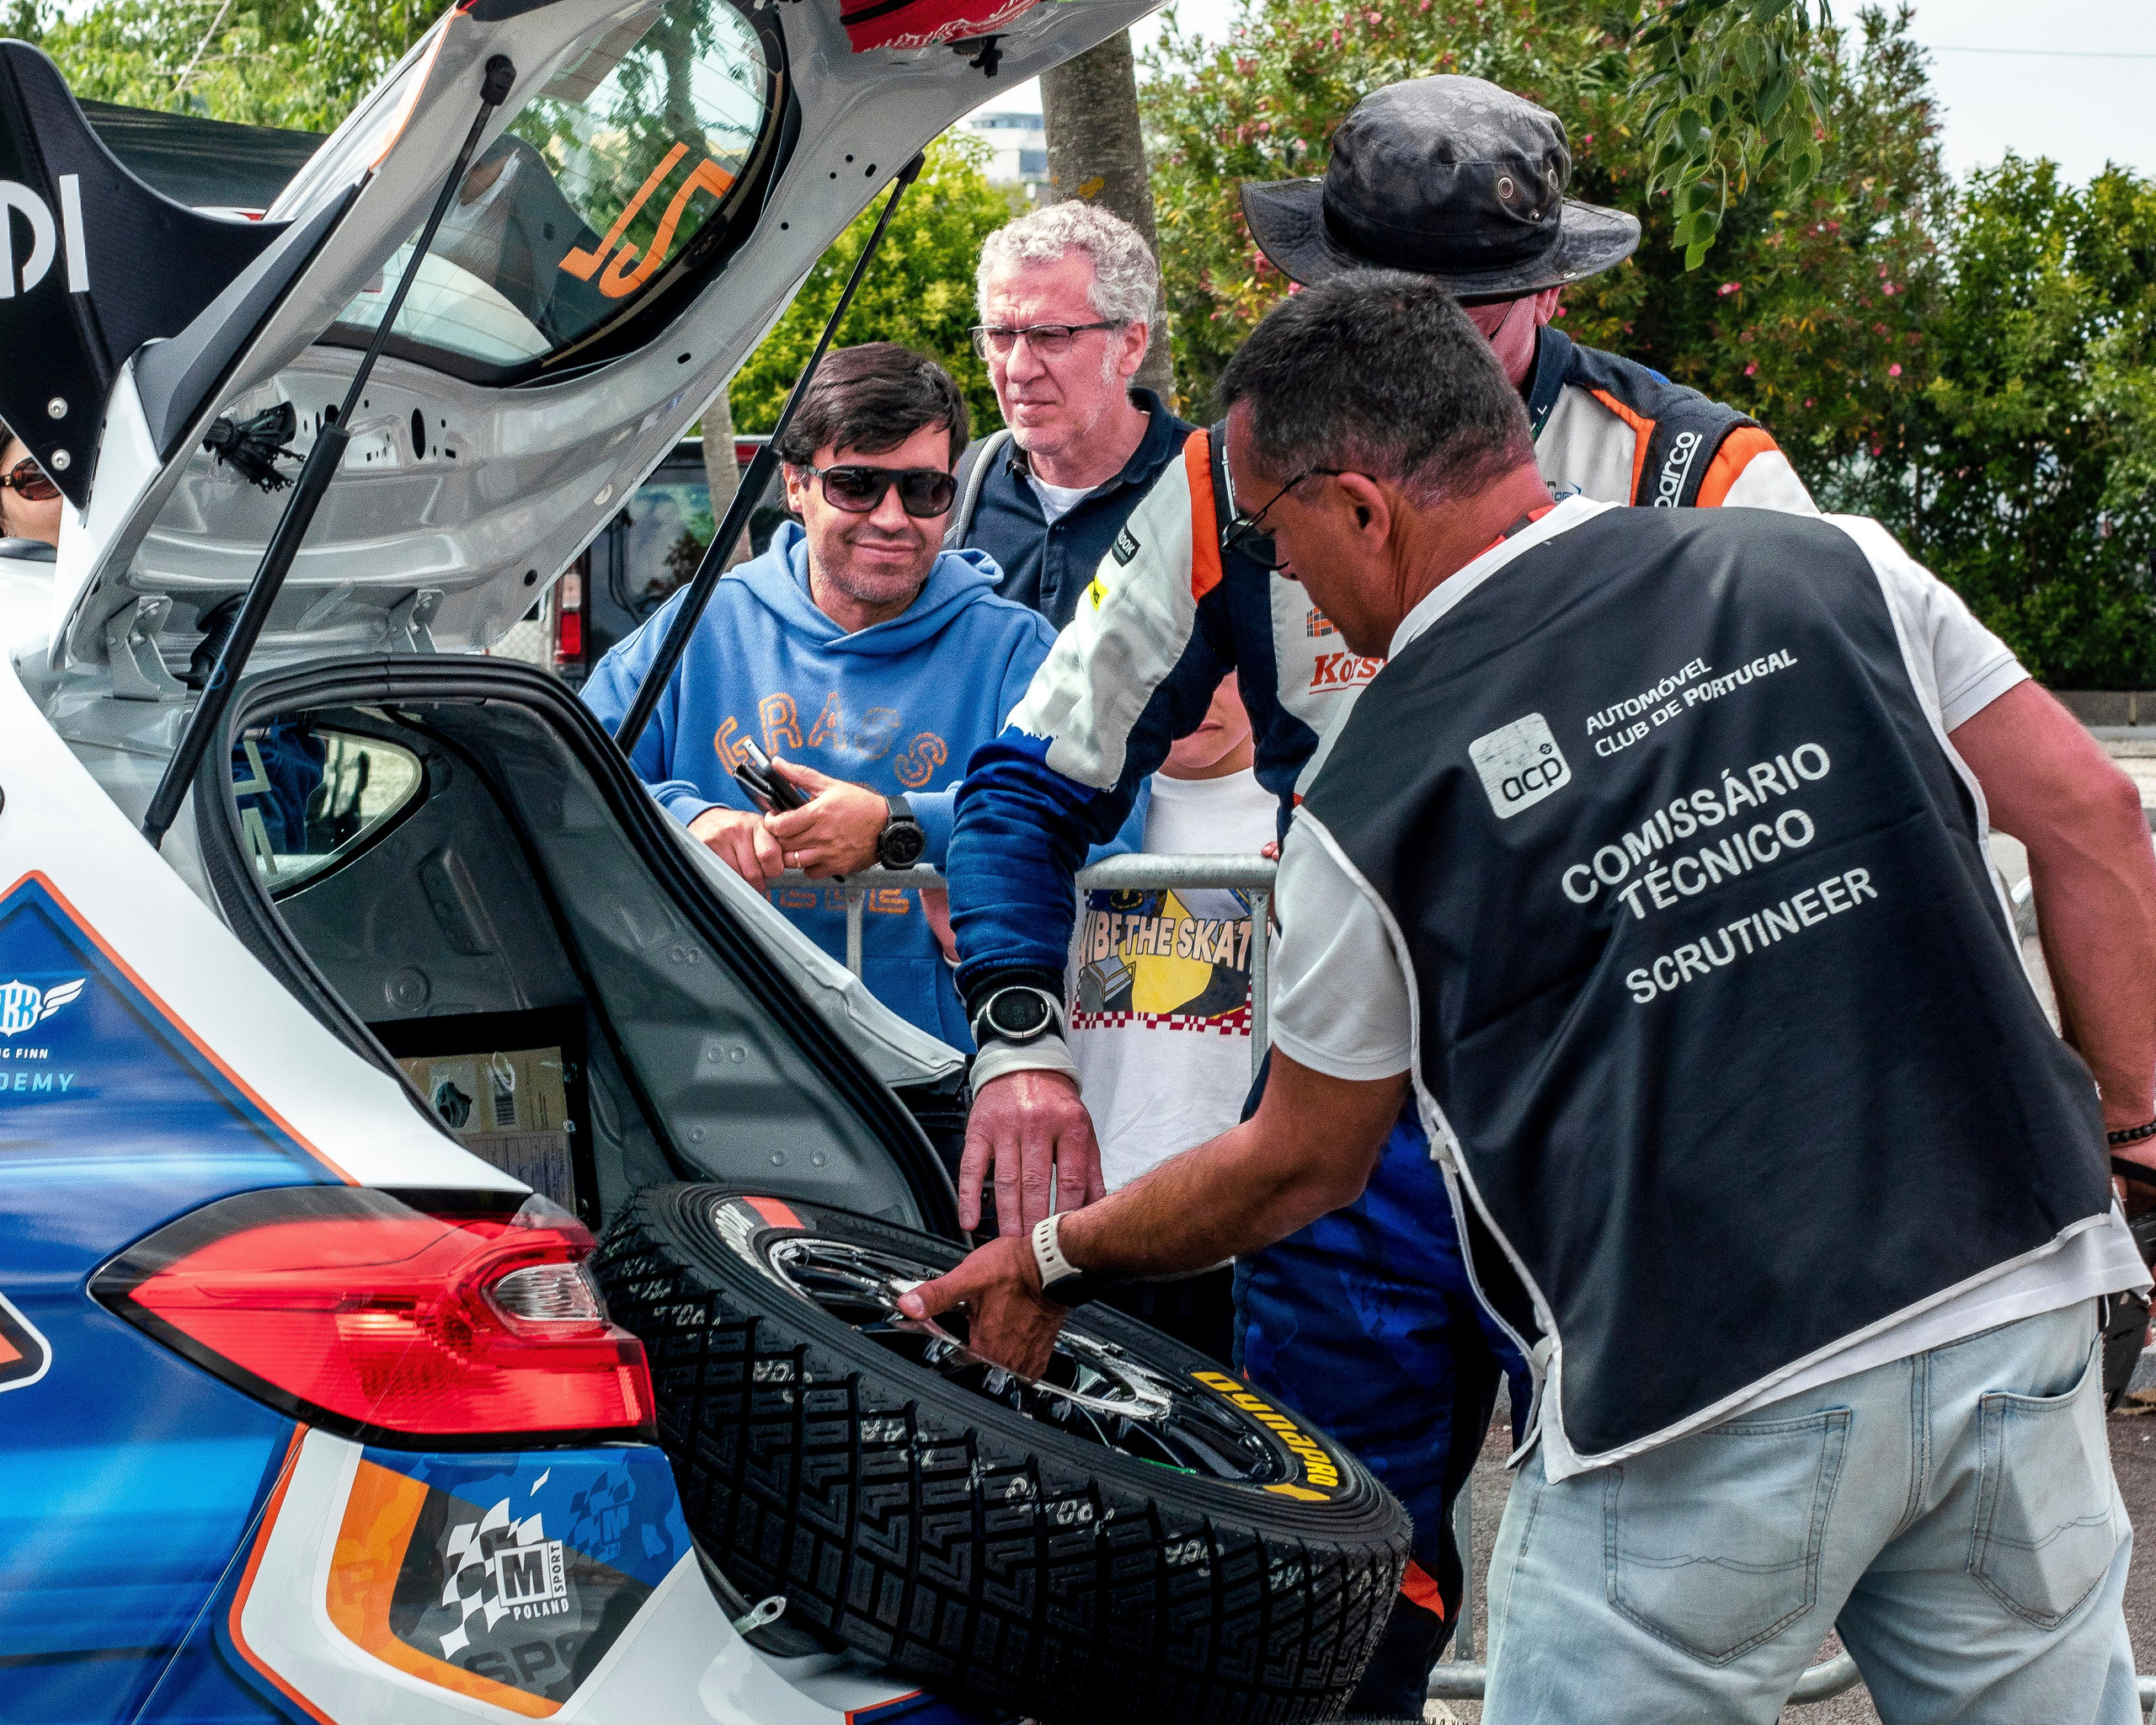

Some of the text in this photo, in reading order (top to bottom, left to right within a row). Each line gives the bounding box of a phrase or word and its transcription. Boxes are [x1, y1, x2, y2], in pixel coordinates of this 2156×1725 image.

[1310, 652, 1389, 687] Kors
[1585, 657, 1713, 735] AUTOMÓVEL
[1594, 648, 1798, 757] CLUB DE PORTUGAL
[1500, 756, 1564, 803] acp
[1561, 742, 1831, 905] COMISSÁRIO
[1618, 809, 1816, 920] TÉCNICO
[1124, 914, 1177, 958] THE
[1625, 868, 1879, 1005] SCRUTINEER
[15, 1048, 49, 1060] FINN
[501, 1548, 546, 1601] M
[552, 1544, 565, 1593] SPORT
[512, 1597, 570, 1621] POLAND
